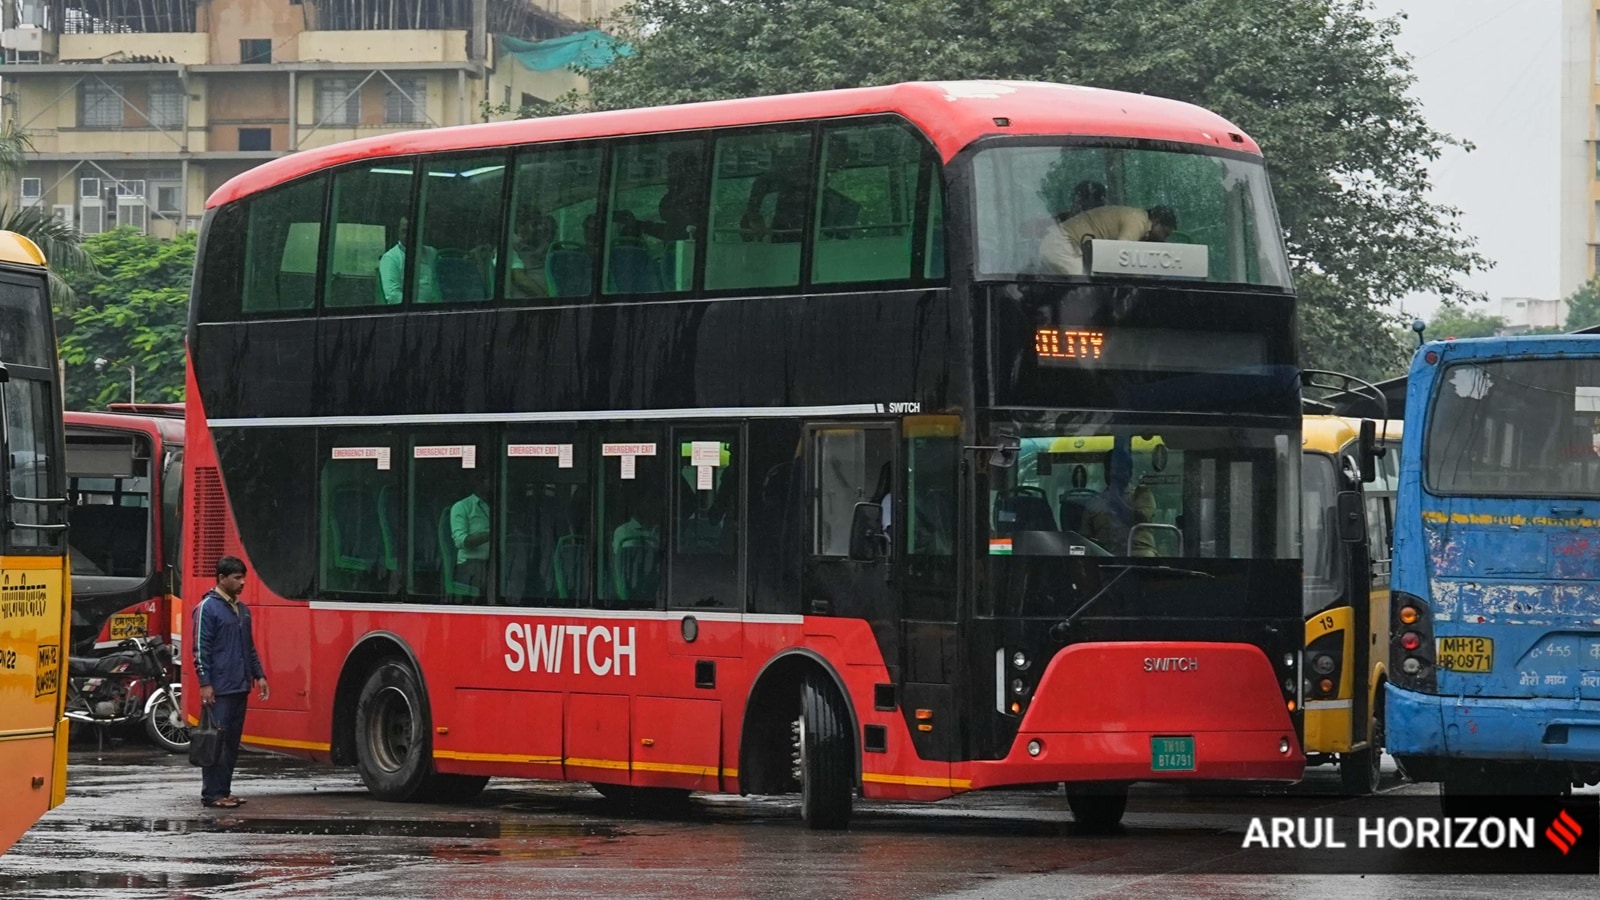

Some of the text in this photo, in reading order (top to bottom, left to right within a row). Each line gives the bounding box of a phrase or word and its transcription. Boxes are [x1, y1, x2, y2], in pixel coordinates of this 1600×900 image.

[1119, 250, 1183, 269] SWITCH
[1035, 329, 1103, 358] ILITY
[888, 402, 920, 413] SWITCH
[333, 449, 377, 457] EMERGENCY EXIT
[416, 447, 448, 456] EMERGENCY
[449, 447, 461, 456] EXIT
[510, 446, 544, 455] EMERGENCY
[545, 446, 557, 455] EXIT
[604, 445, 654, 454] EMERGENCY EXIT
[1319, 616, 1334, 630] 19
[504, 622, 637, 676] SWITCH
[1443, 638, 1485, 653] MH-12
[1143, 657, 1198, 672] SWITCH
[1158, 754, 1192, 767] BT4791
